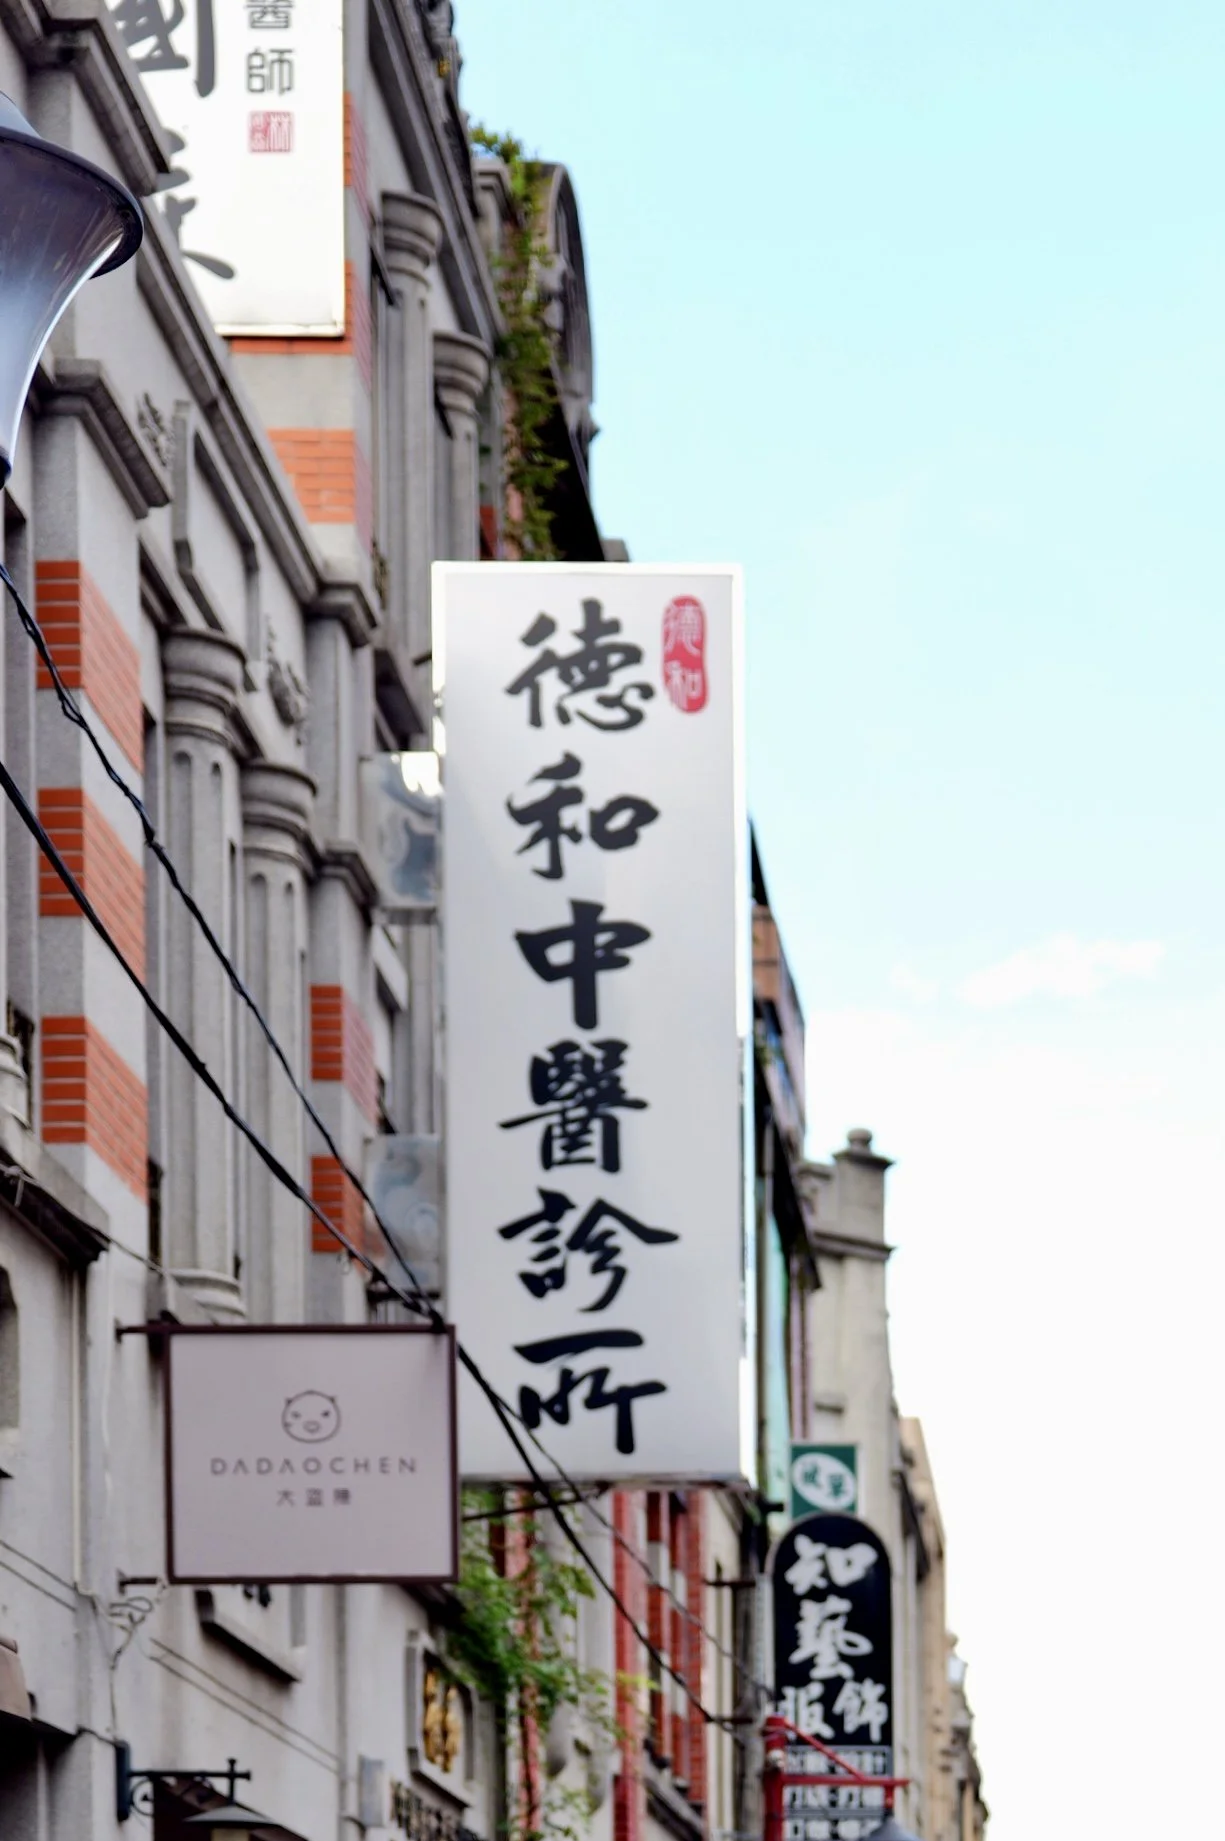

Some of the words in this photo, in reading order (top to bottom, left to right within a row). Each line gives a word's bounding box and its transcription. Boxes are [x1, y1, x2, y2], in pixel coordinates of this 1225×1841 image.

[499, 599, 681, 1457] 德和中醫診所
[210, 1456, 417, 1476] DADAOCHEN
